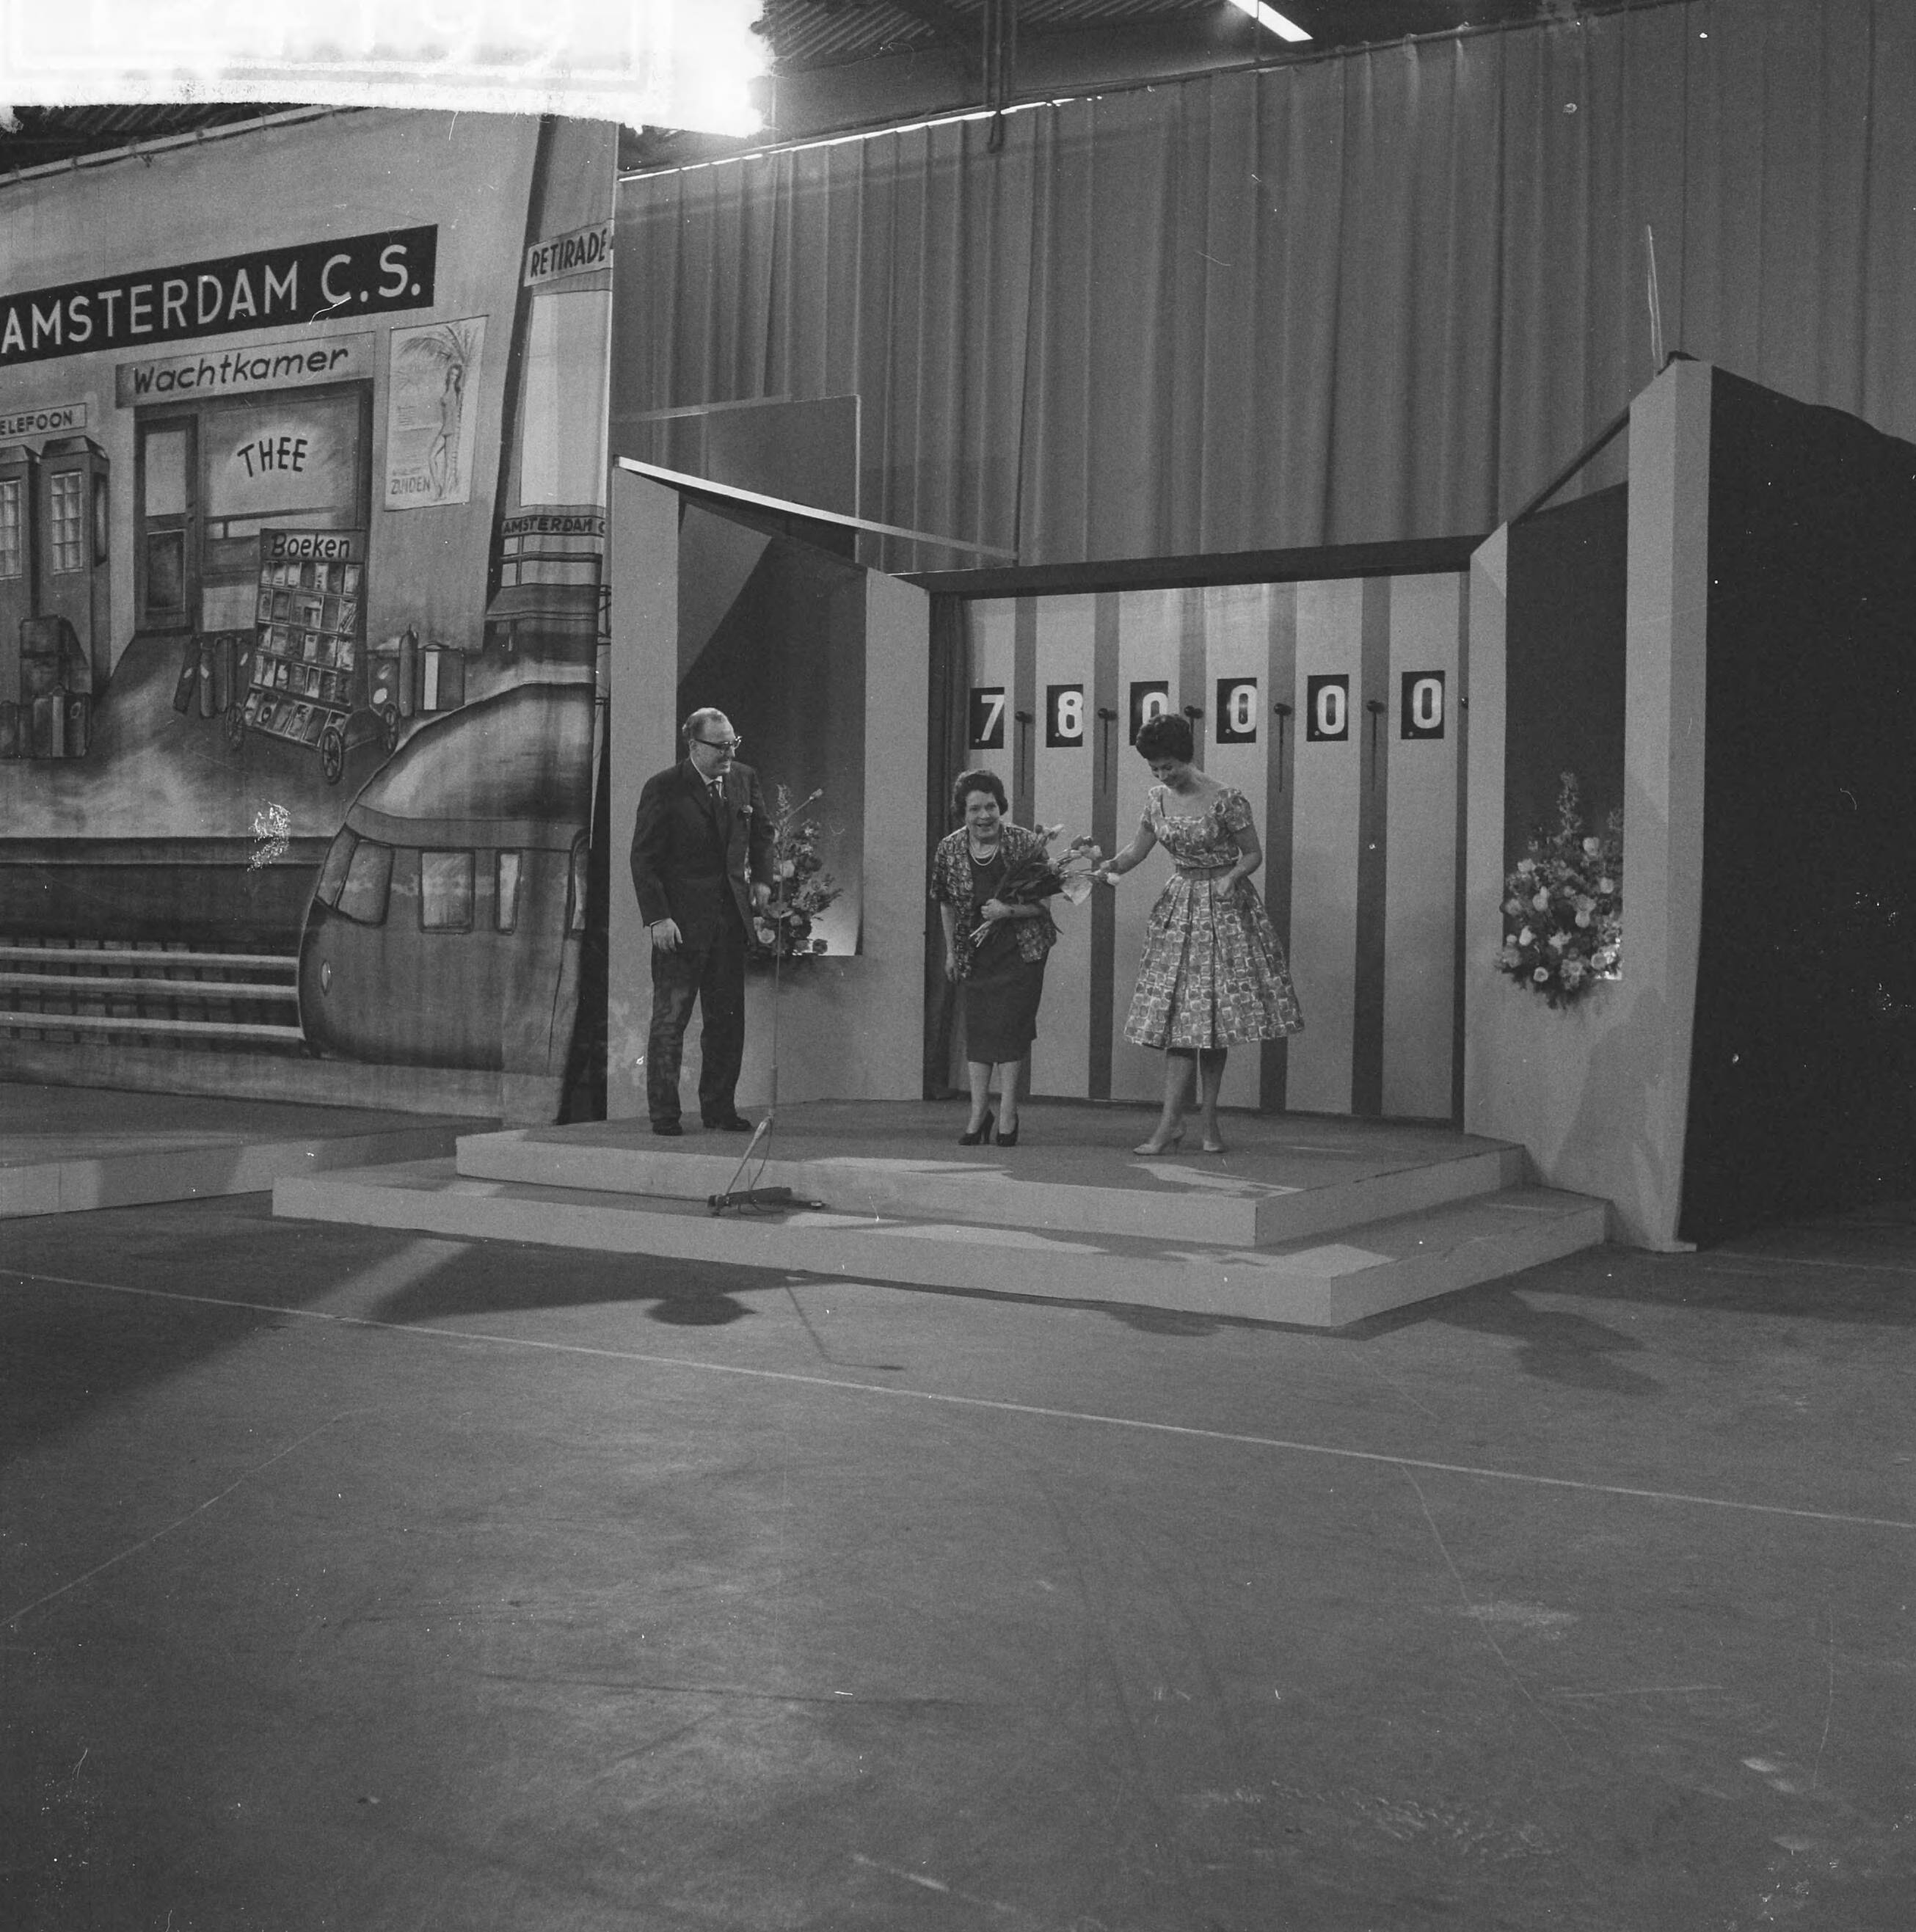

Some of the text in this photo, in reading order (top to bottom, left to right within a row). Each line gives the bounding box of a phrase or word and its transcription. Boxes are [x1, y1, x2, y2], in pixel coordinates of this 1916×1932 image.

[531, 227, 607, 277] RETIRADE
[1, 244, 421, 354] AMSTERDAM C.S.
[134, 348, 349, 394] Wachtkamer
[237, 437, 307, 477] THEE
[271, 533, 351, 558] Boeken
[504, 517, 593, 533] AMSTERDAM
